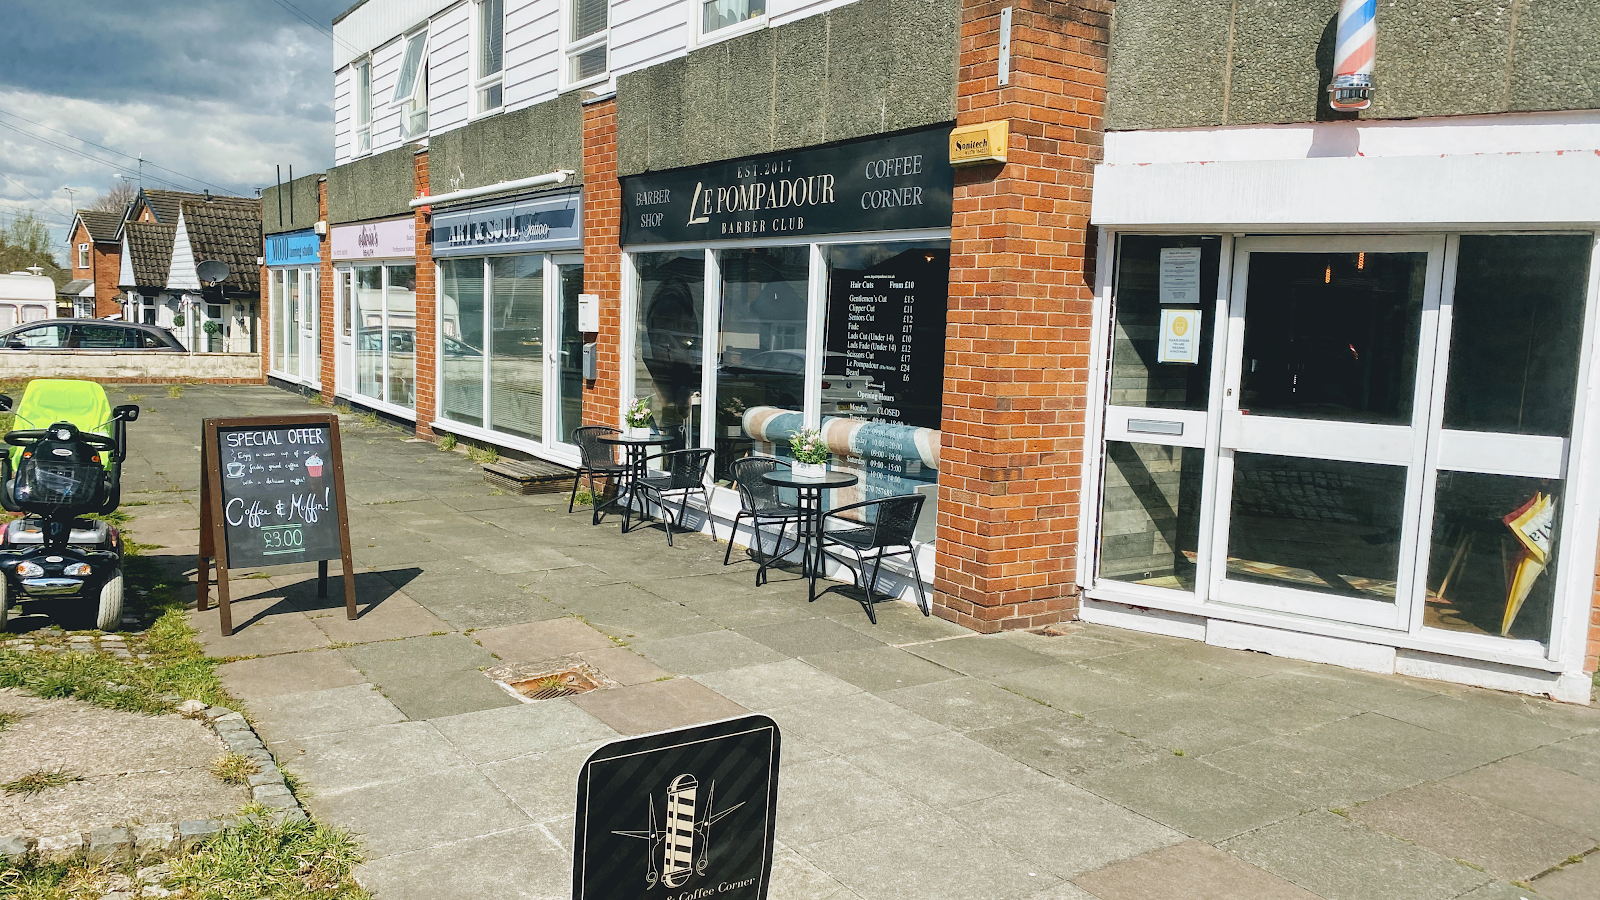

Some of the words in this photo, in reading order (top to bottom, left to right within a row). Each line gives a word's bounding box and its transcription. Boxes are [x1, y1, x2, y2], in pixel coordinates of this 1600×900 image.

[866, 154, 922, 180] COFFEE
[636, 189, 670, 206] BARBER
[716, 174, 835, 214] POMPADOUR
[861, 186, 923, 210] CORNER
[641, 212, 664, 228] SHOP
[722, 220, 766, 234] BARBER
[772, 216, 804, 231] CLUB
[448, 221, 472, 243] ART
[272, 238, 288, 260] MOJO
[904, 281, 914, 289] £10
[849, 304, 866, 313] Clipper
[868, 333, 885, 342] (Under
[886, 334, 894, 342] 14)
[847, 350, 865, 358] Scissors
[871, 343, 888, 352] (Under
[888, 344, 896, 353] 14)
[846, 368, 859, 376] Beard
[853, 360, 879, 370] Pompadour
[900, 364, 910, 372] £24
[857, 390, 878, 401] Opening
[879, 393, 895, 402] Hours
[850, 403, 868, 413] Monday
[877, 407, 900, 417] CLOSED
[226, 431, 282, 447] SPECIAL
[288, 428, 324, 444] OFFER
[226, 498, 272, 528] Coffee
[276, 500, 286, 518] &
[288, 486, 330, 523] Muffin!
[264, 529, 302, 548] £3.00
[679, 888, 714, 900] Coffee
[718, 877, 755, 893] Corner
